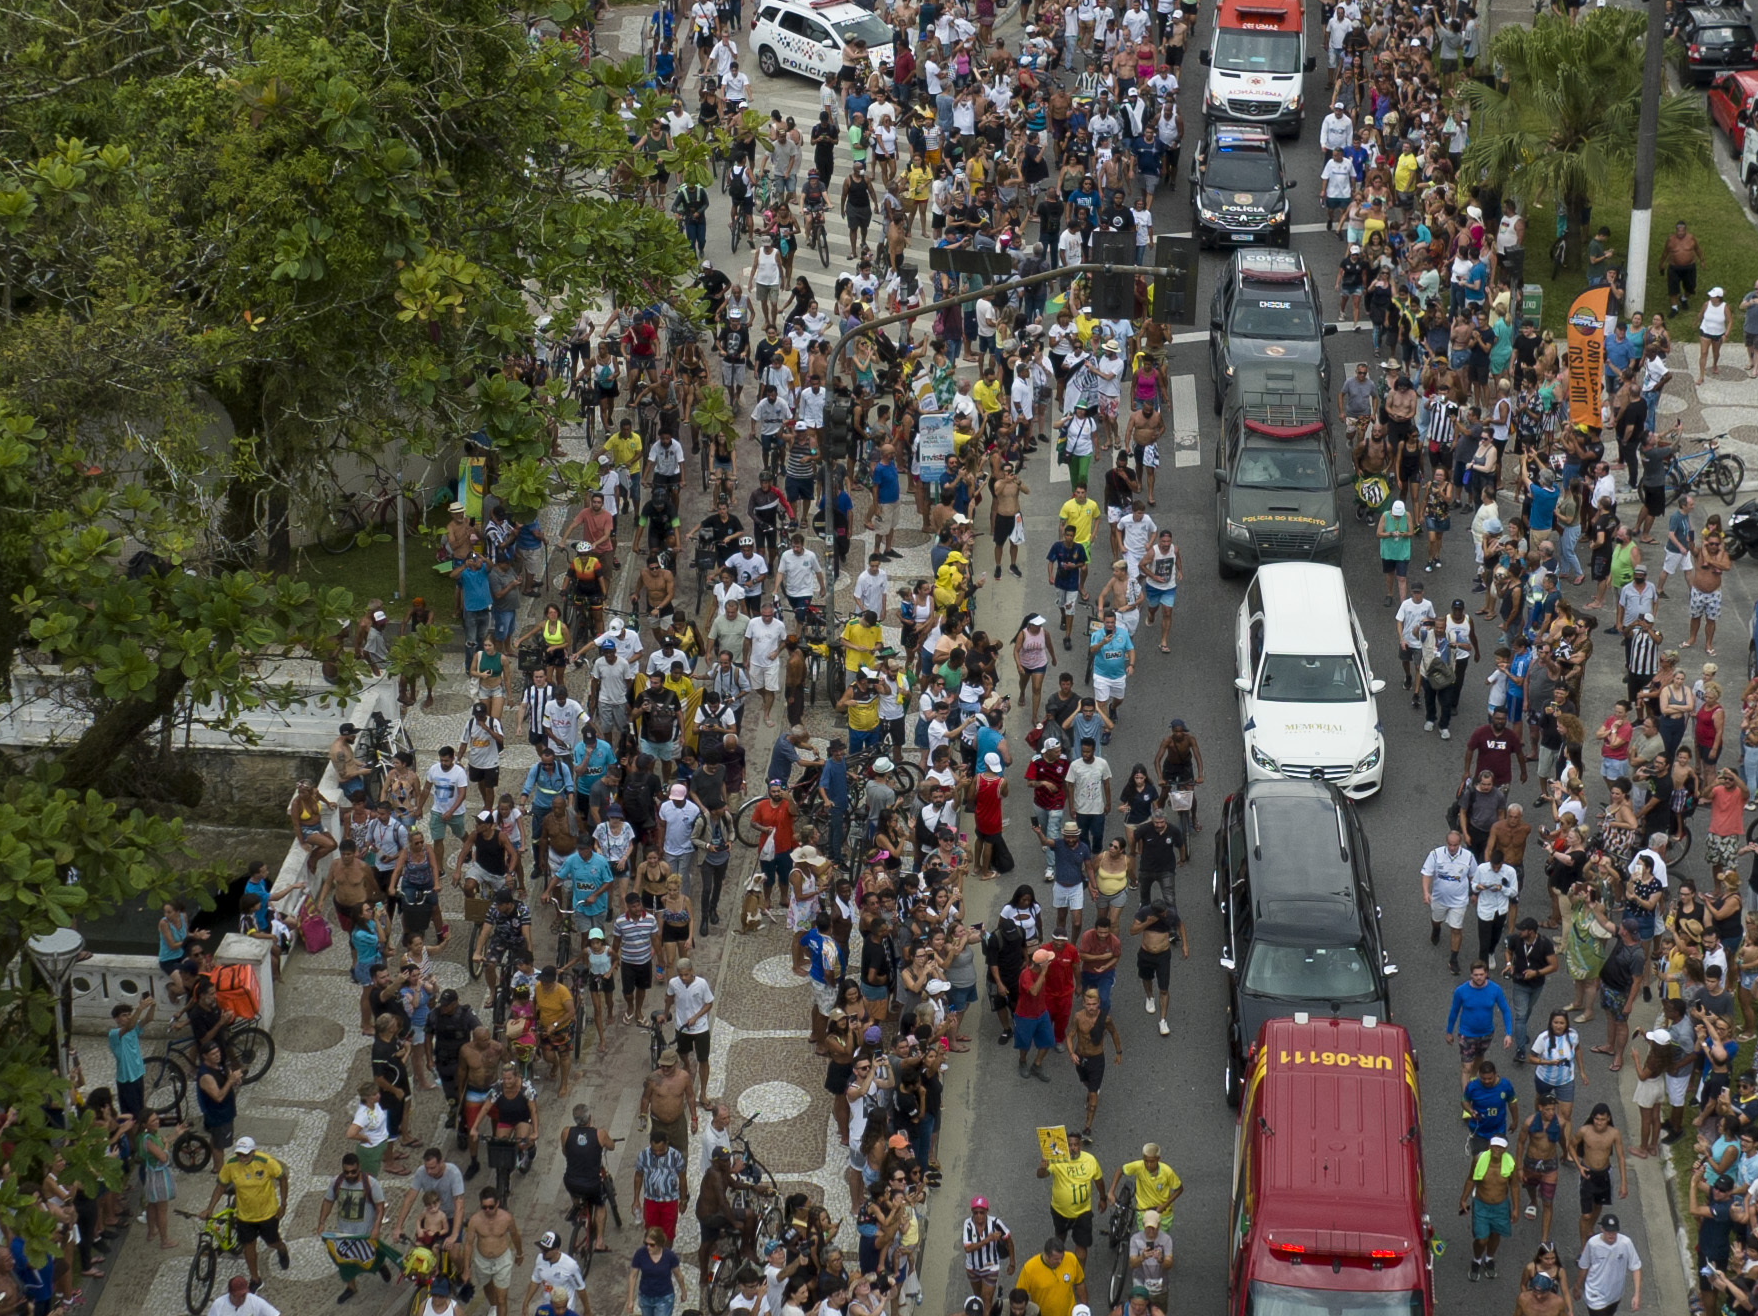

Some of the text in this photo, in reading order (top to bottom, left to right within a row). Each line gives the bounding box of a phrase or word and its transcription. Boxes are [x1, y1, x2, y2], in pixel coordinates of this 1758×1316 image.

[1284, 723, 1343, 732] MEMORIAL
[1280, 1050, 1393, 1071] UR-06111
[1071, 1183, 1088, 1206] 10
